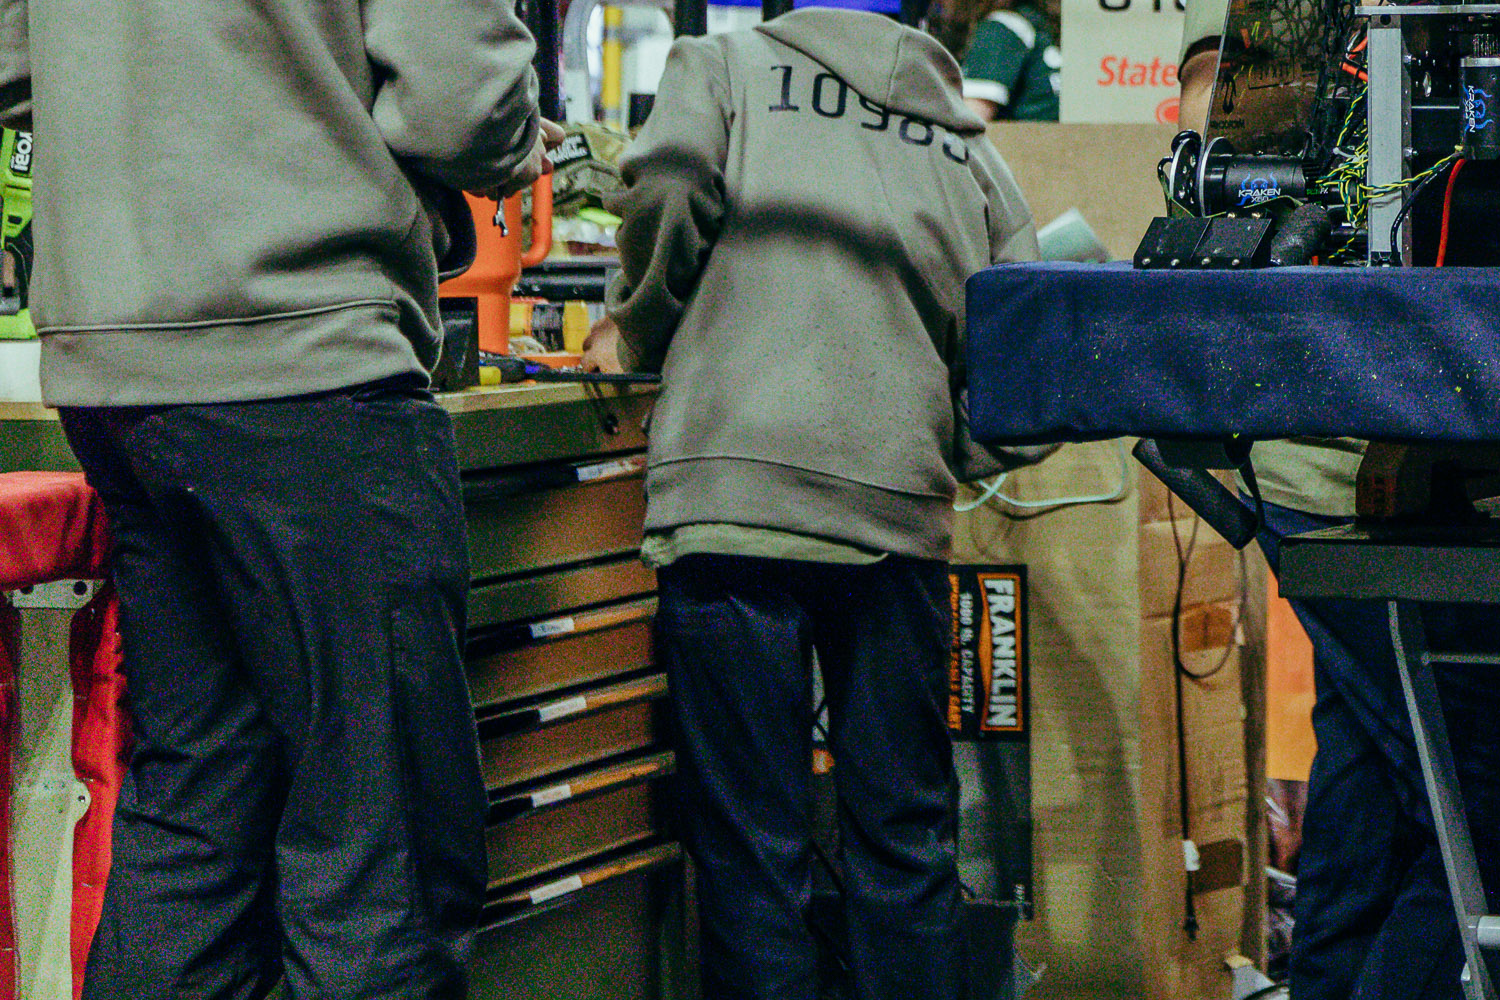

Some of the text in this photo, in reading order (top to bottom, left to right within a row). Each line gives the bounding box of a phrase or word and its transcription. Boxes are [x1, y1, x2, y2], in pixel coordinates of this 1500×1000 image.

[1097, 55, 1178, 88] State
[1468, 85, 1476, 133] KRAKEN
[1238, 187, 1281, 198] KRAKEN
[983, 578, 1017, 727] FRANKLIN
